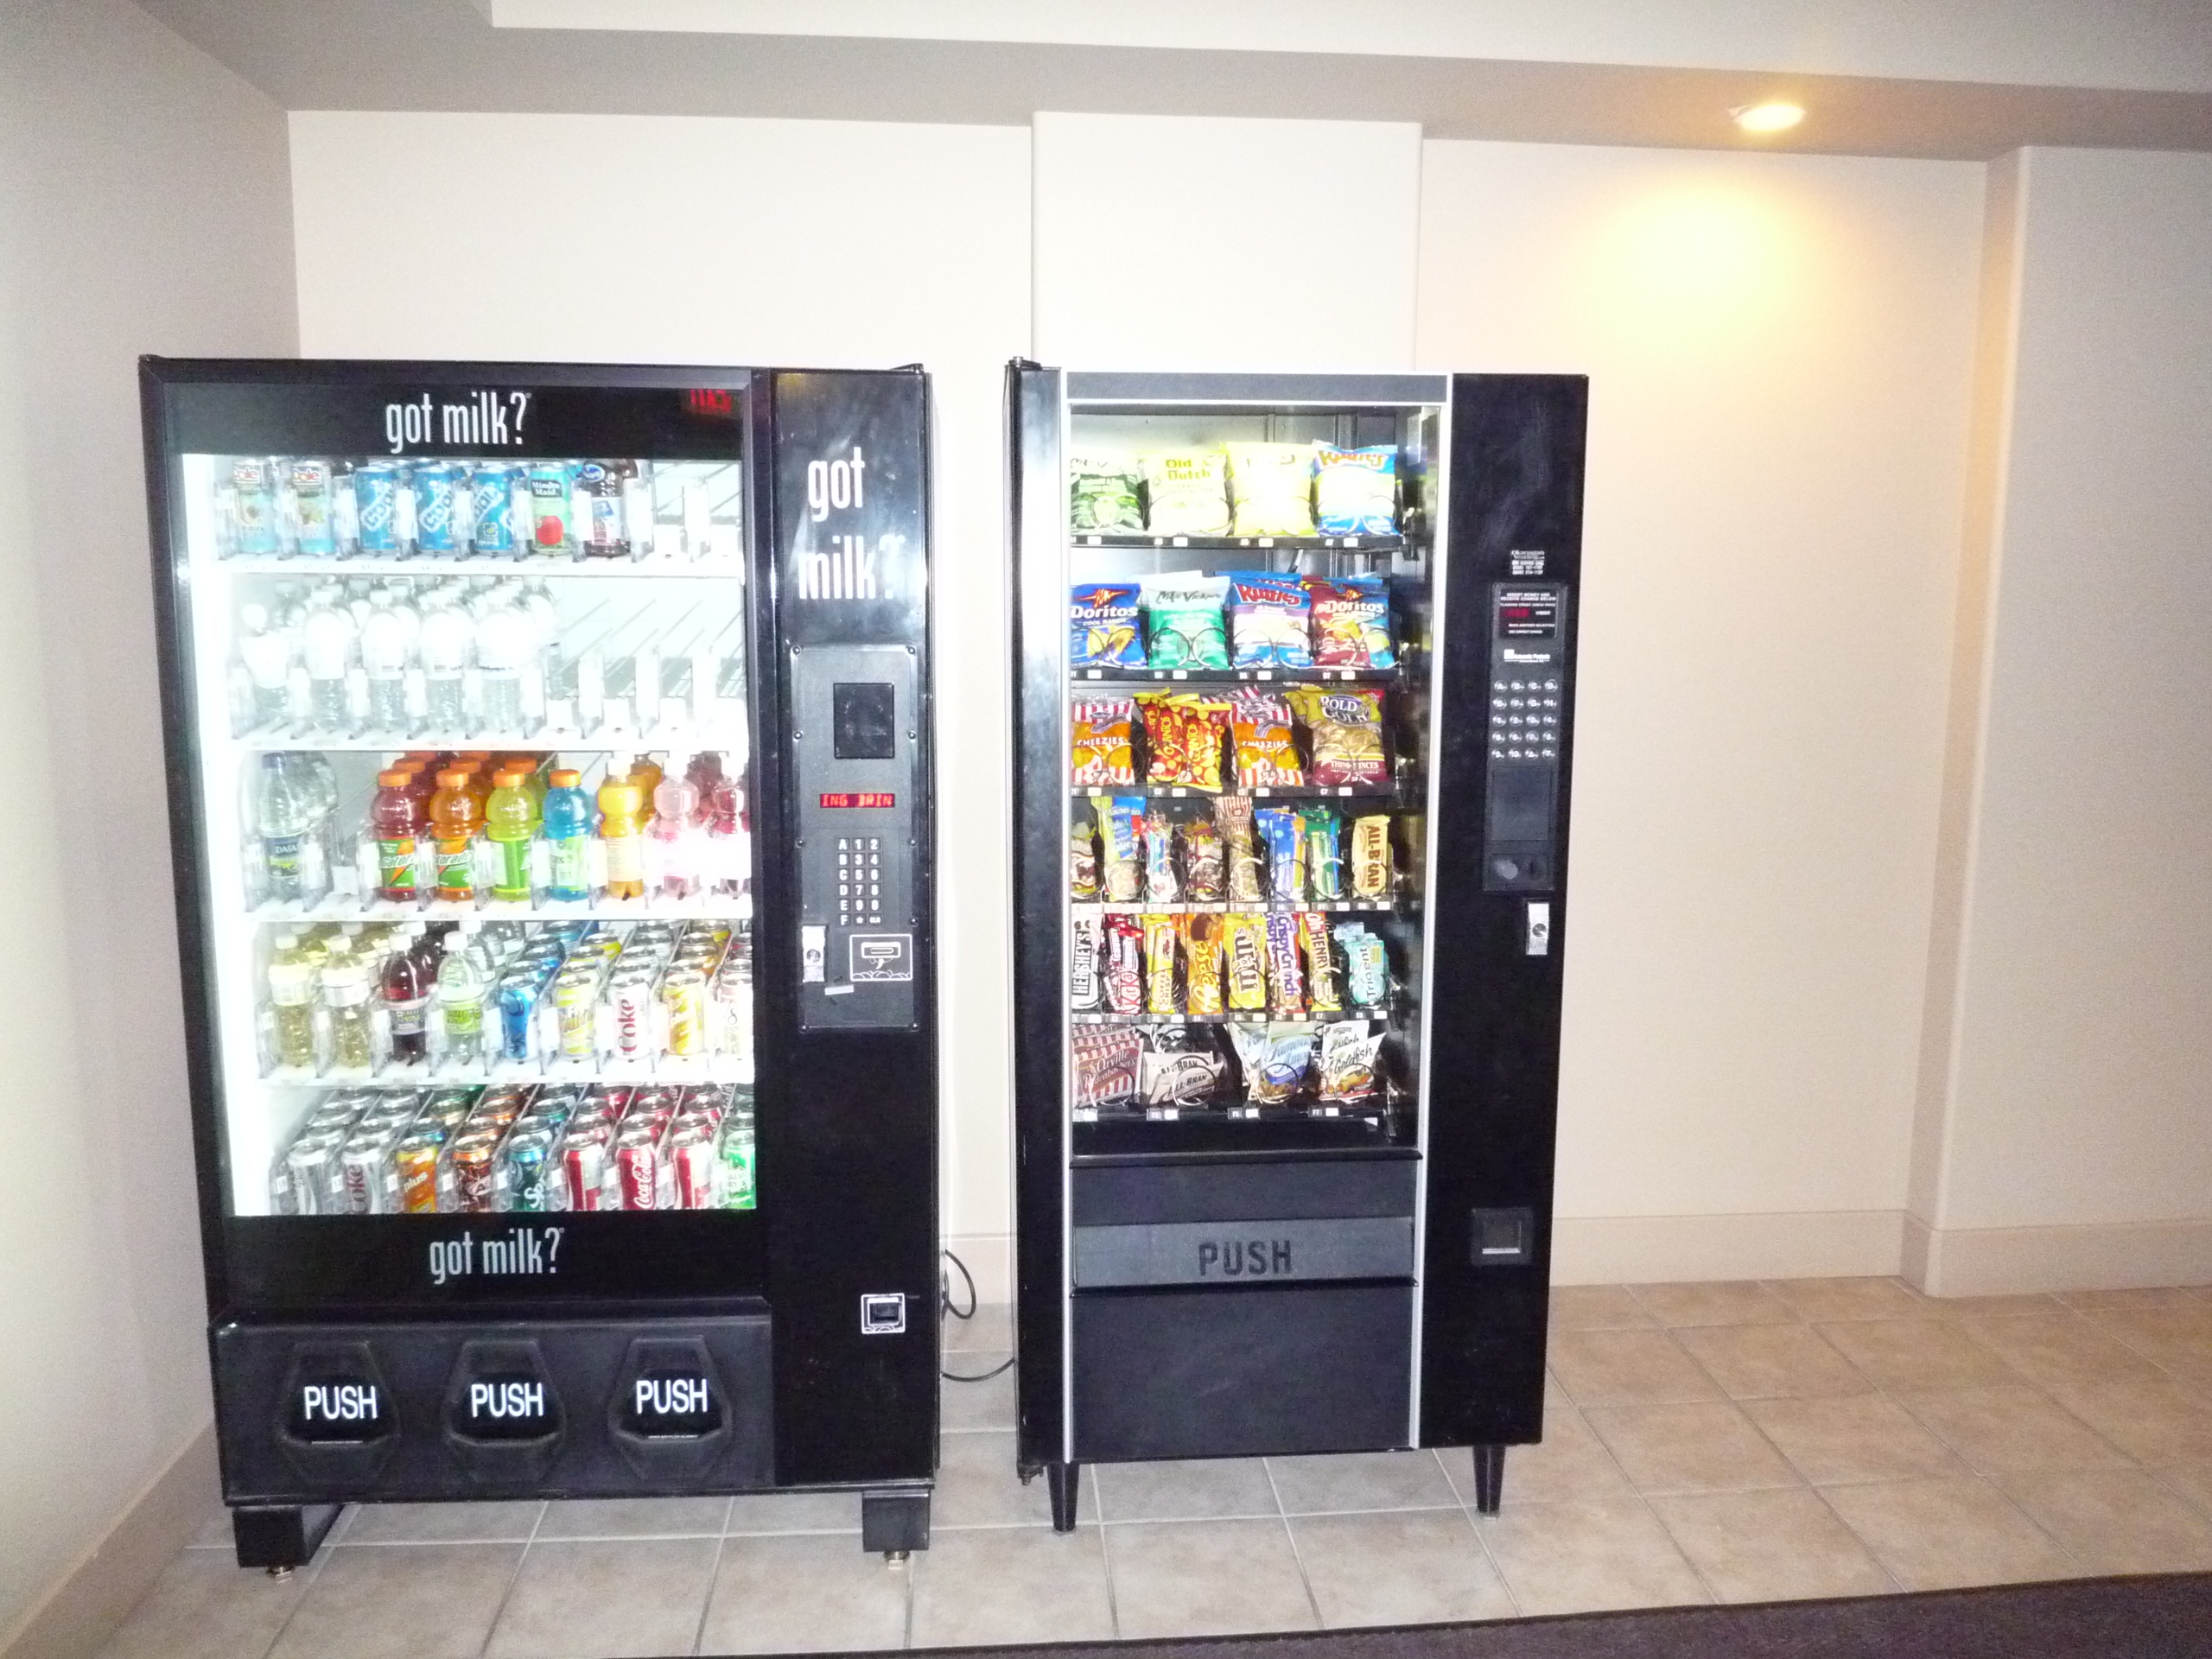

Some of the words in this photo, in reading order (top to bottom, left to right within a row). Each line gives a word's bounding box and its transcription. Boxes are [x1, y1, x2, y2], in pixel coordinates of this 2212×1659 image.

[386, 393, 432, 454] got
[443, 391, 528, 445] milk?
[1166, 459, 1192, 468] Old
[1168, 469, 1210, 480] Dutch
[531, 480, 560, 490] Minute
[808, 447, 865, 522] got
[1071, 604, 1138, 619] Doritos
[1325, 600, 1384, 614] Doritos
[1320, 696, 1357, 711] ROLD
[1077, 736, 1124, 747] CHEEZIES
[822, 794, 848, 806] ING
[276, 844, 298, 855] DASA
[838, 838, 848, 850] A
[855, 838, 862, 850] 1
[870, 838, 878, 850] 2
[839, 854, 847, 865] B
[855, 854, 862, 865] 3
[870, 854, 878, 865] 4
[839, 869, 848, 880] C
[855, 869, 862, 880] 5
[871, 869, 878, 880] 6
[839, 885, 848, 896] D
[855, 885, 862, 896] 7
[871, 885, 879, 896] 8
[840, 899, 848, 911] E
[855, 899, 862, 911] 9
[840, 915, 848, 925] F
[1073, 932, 1092, 995] HERSHEY'S
[1360, 947, 1376, 999] Trident
[618, 999, 638, 1052] Coke
[1096, 1049, 1129, 1072] Orville
[1334, 1043, 1372, 1074] Goldfish
[404, 1172, 428, 1192] plus
[429, 1232, 473, 1285] got
[482, 1227, 561, 1274] milk?
[1198, 1240, 1293, 1276] PUSH
[305, 1385, 378, 1420] PUSH
[472, 1382, 544, 1417] PUSH
[636, 1379, 709, 1414] PUSH
